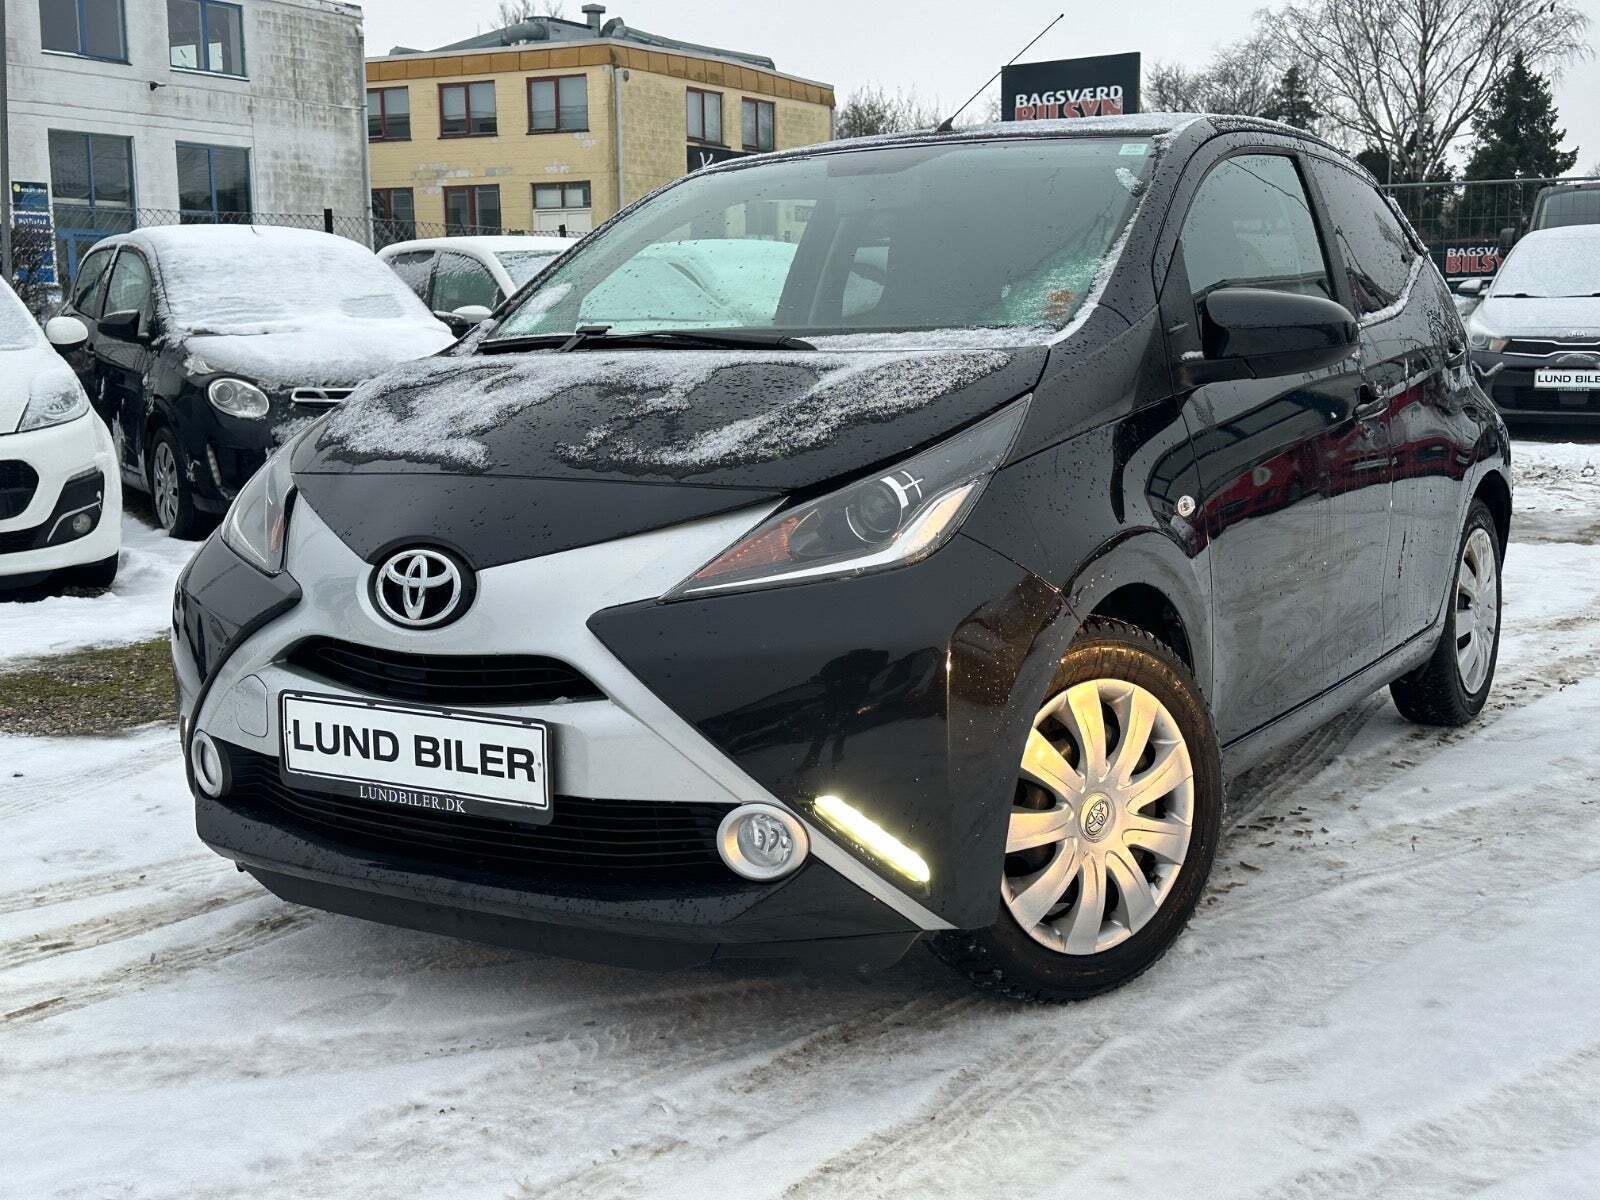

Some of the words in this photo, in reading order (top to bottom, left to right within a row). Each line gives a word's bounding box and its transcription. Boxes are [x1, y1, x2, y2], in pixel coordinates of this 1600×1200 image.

[1015, 85, 1123, 107] BAGSVÆRD
[1537, 375, 1571, 383] LUND
[292, 719, 400, 763] LUND
[413, 734, 537, 783] BILER
[359, 785, 467, 814] LUNDBILER.DK
